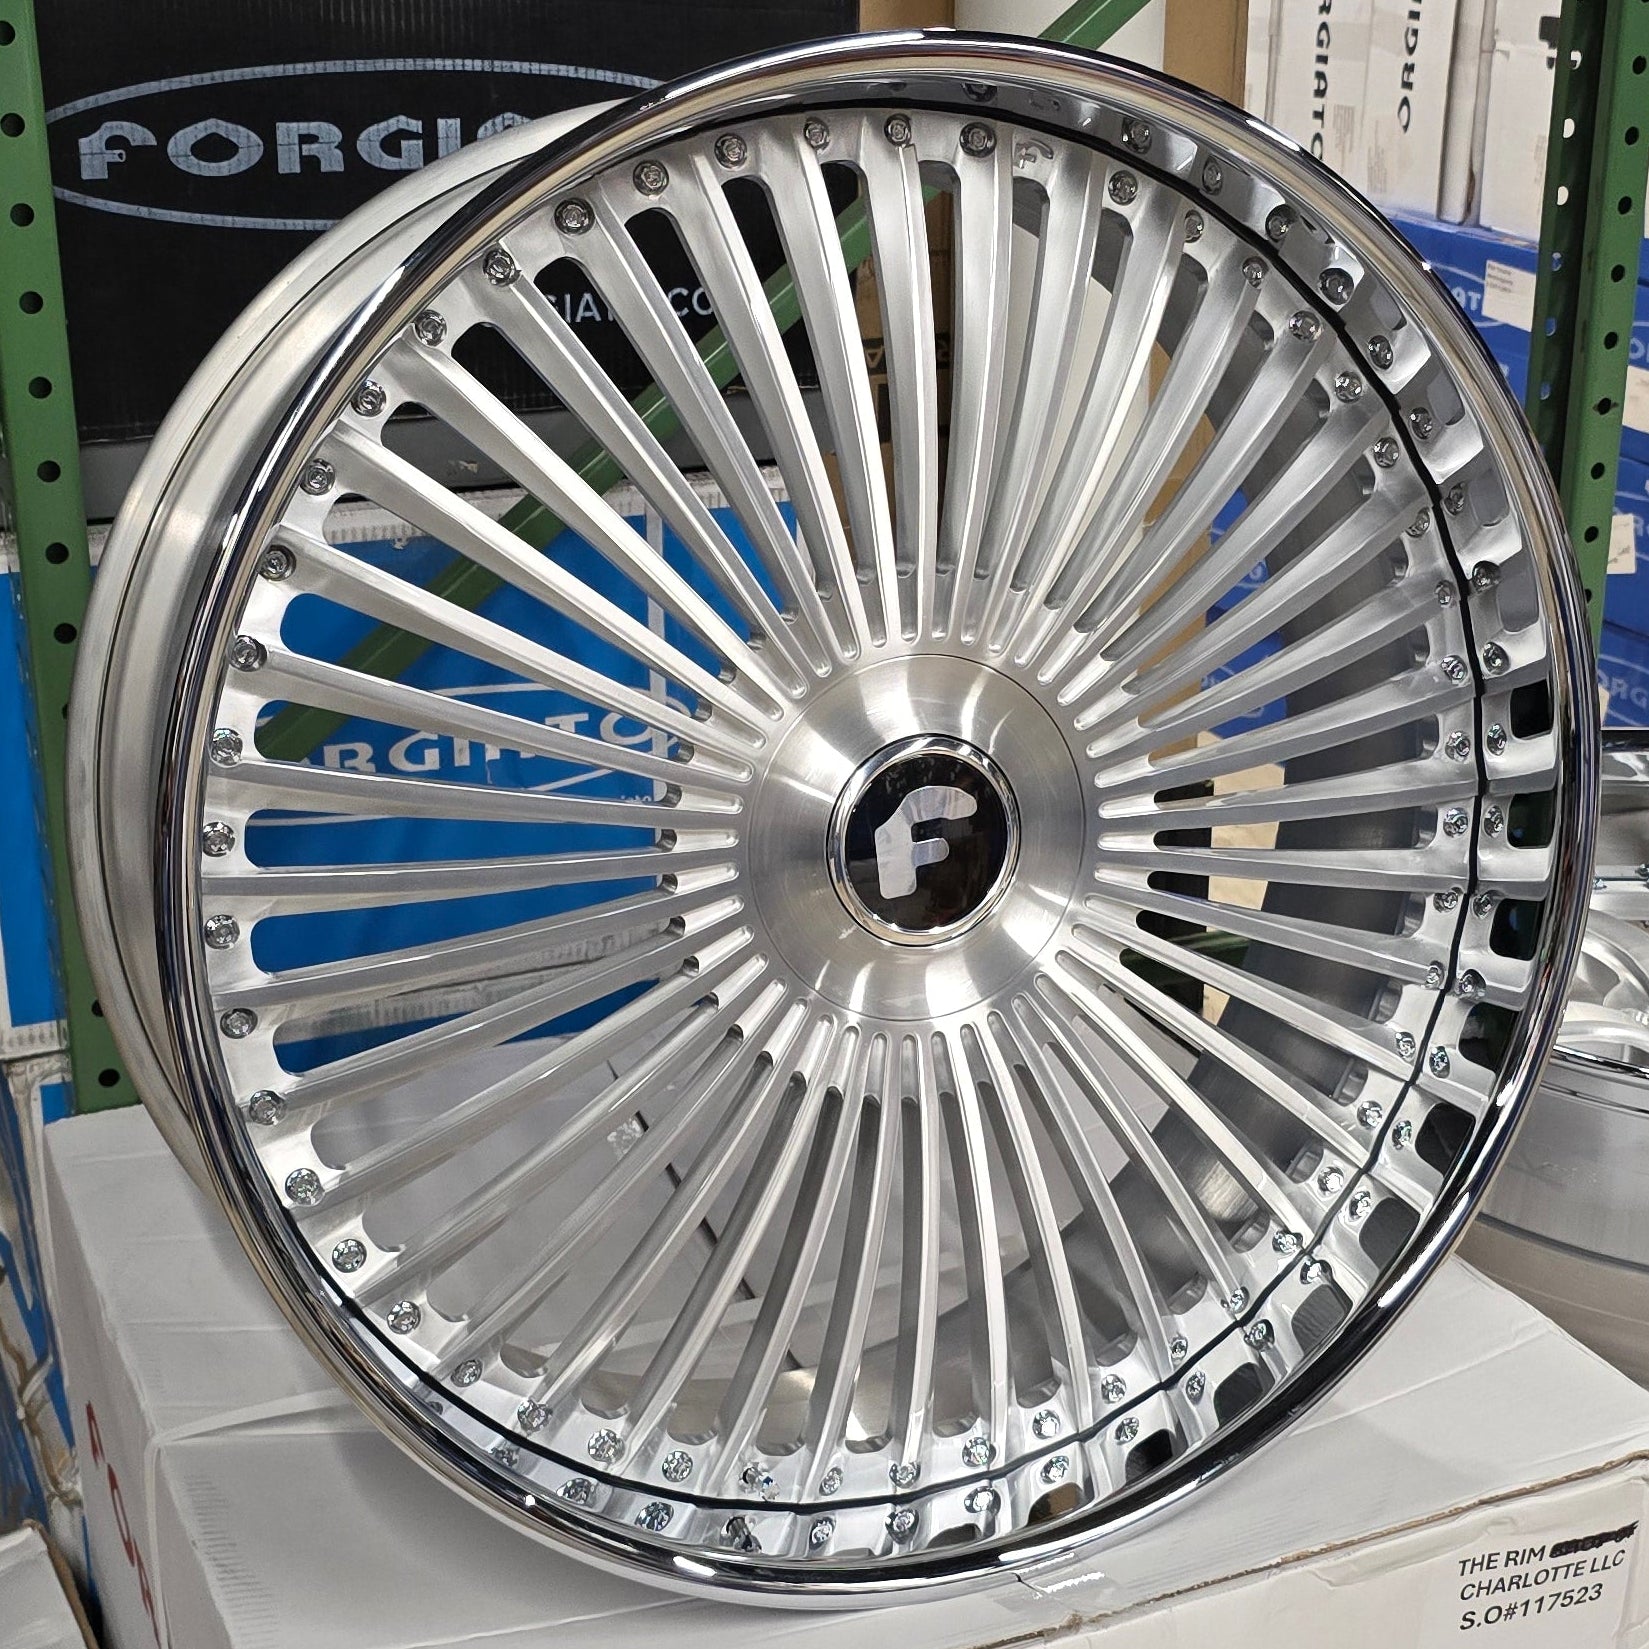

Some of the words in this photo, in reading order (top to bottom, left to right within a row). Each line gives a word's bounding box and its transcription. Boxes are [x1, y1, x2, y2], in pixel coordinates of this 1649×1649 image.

[875, 786, 977, 899] F
[1459, 1552, 1500, 1576] THE
[1504, 1545, 1546, 1567] RIM
[1460, 1560, 1587, 1601] CHARLOTTE
[1590, 1550, 1626, 1574] LLC
[1459, 1583, 1603, 1631] S.O#117523
